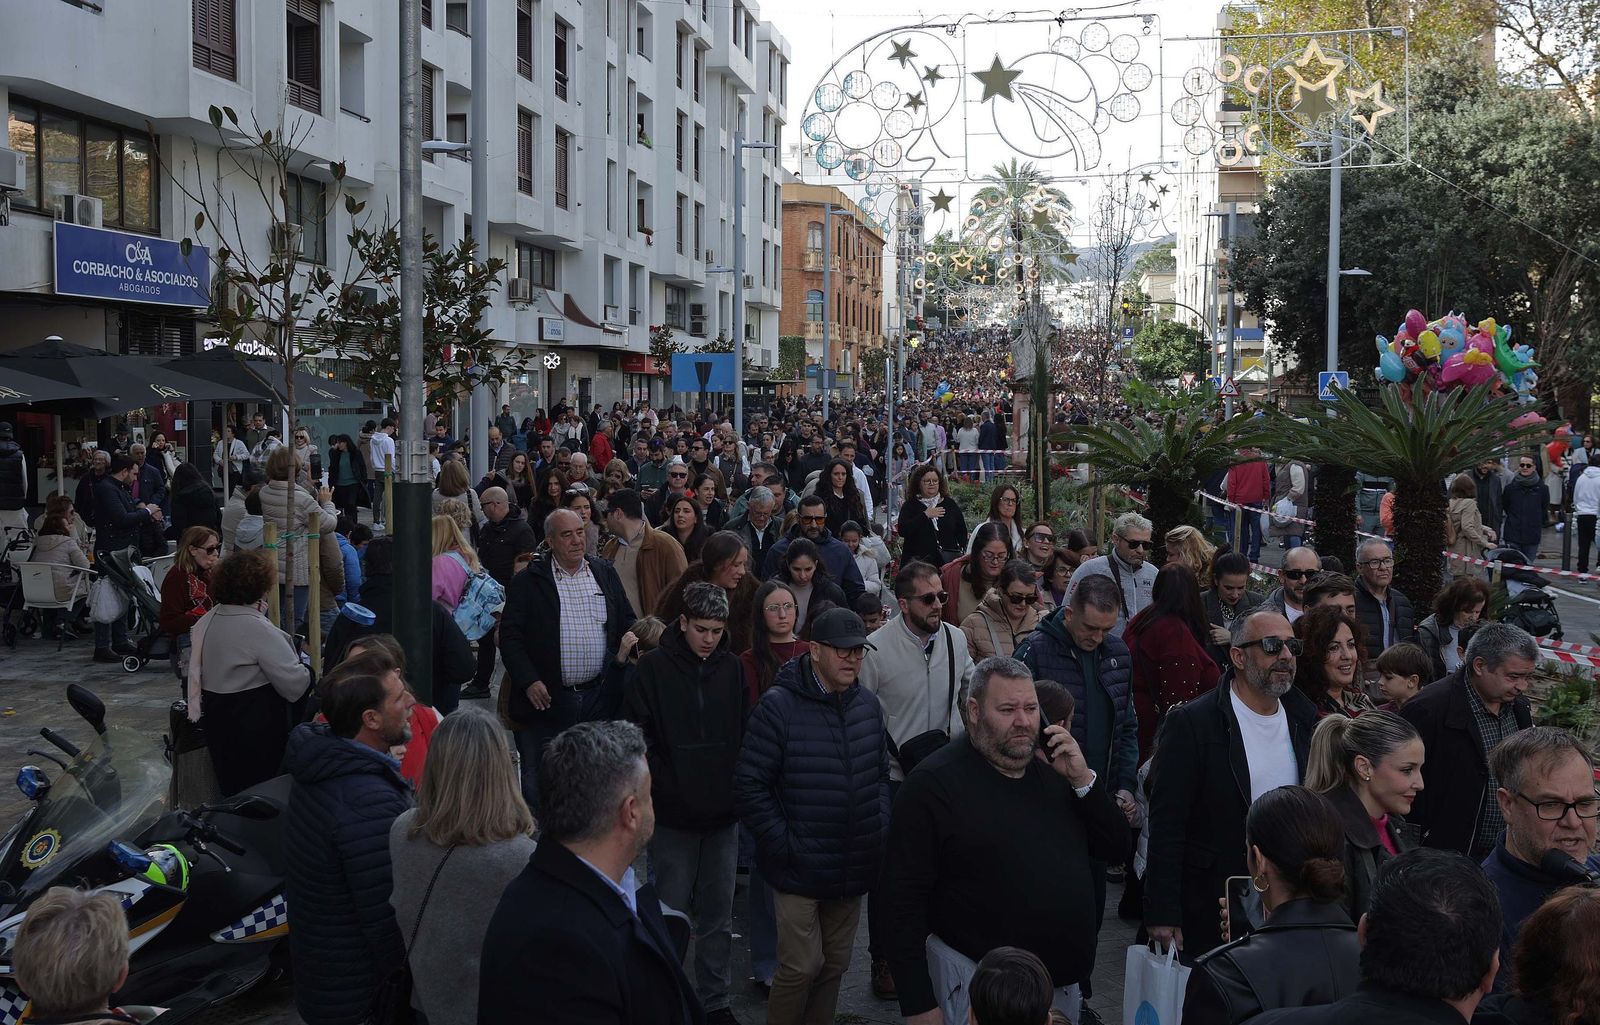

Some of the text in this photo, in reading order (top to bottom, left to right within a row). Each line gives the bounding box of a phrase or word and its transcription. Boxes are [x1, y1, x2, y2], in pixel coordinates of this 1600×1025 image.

[125, 240, 153, 266] C&A
[73, 259, 199, 289] CORBACHO & ASOCIADOS
[118, 282, 161, 296] ABOGADOS
